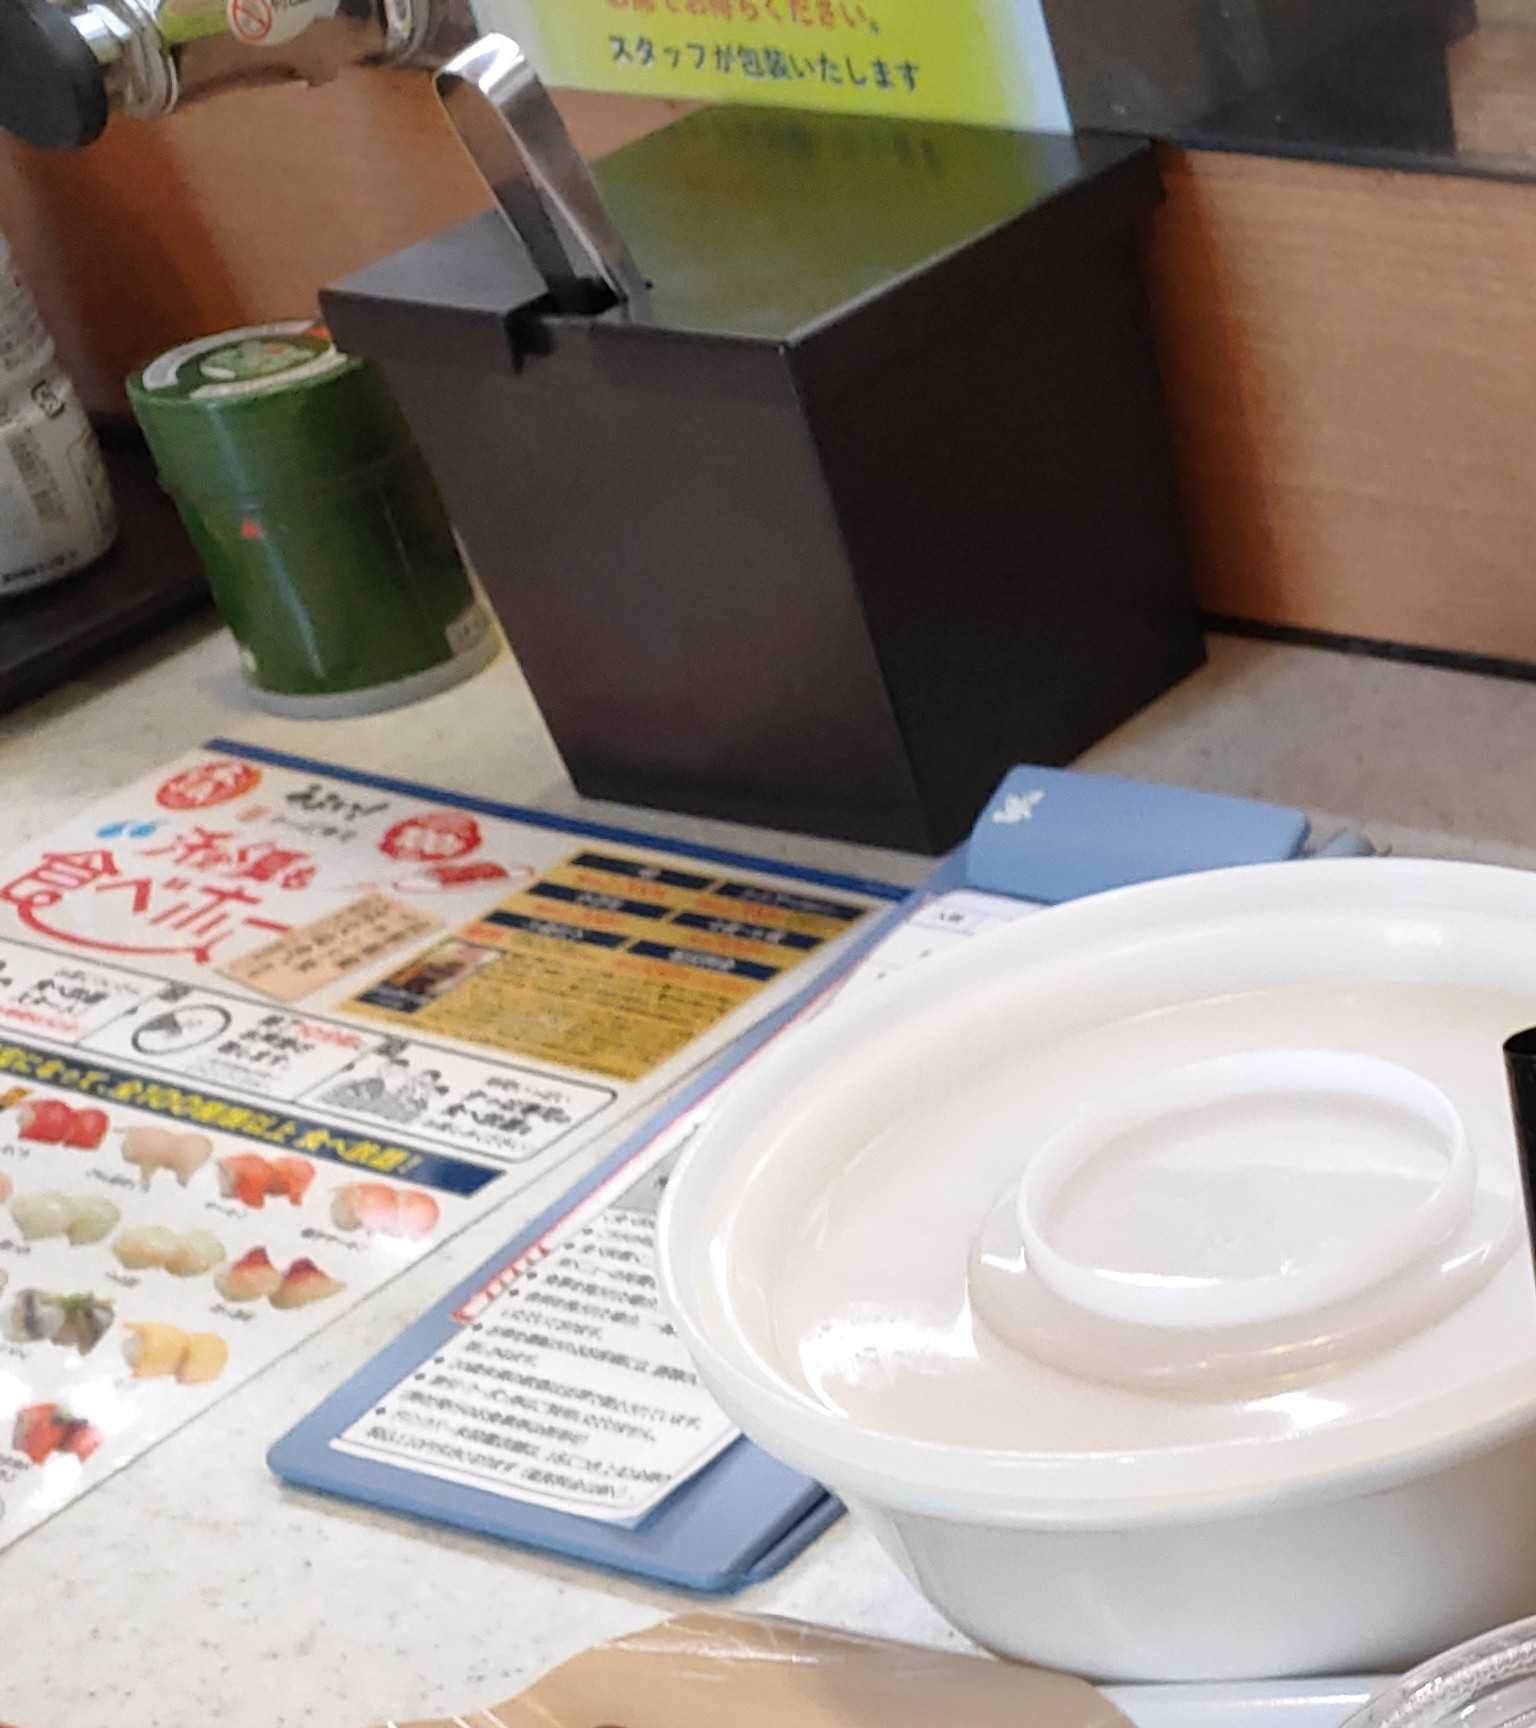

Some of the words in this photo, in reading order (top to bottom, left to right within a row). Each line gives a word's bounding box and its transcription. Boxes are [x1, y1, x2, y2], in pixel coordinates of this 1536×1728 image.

[609, 35, 919, 91] スタッフが包装いたします
